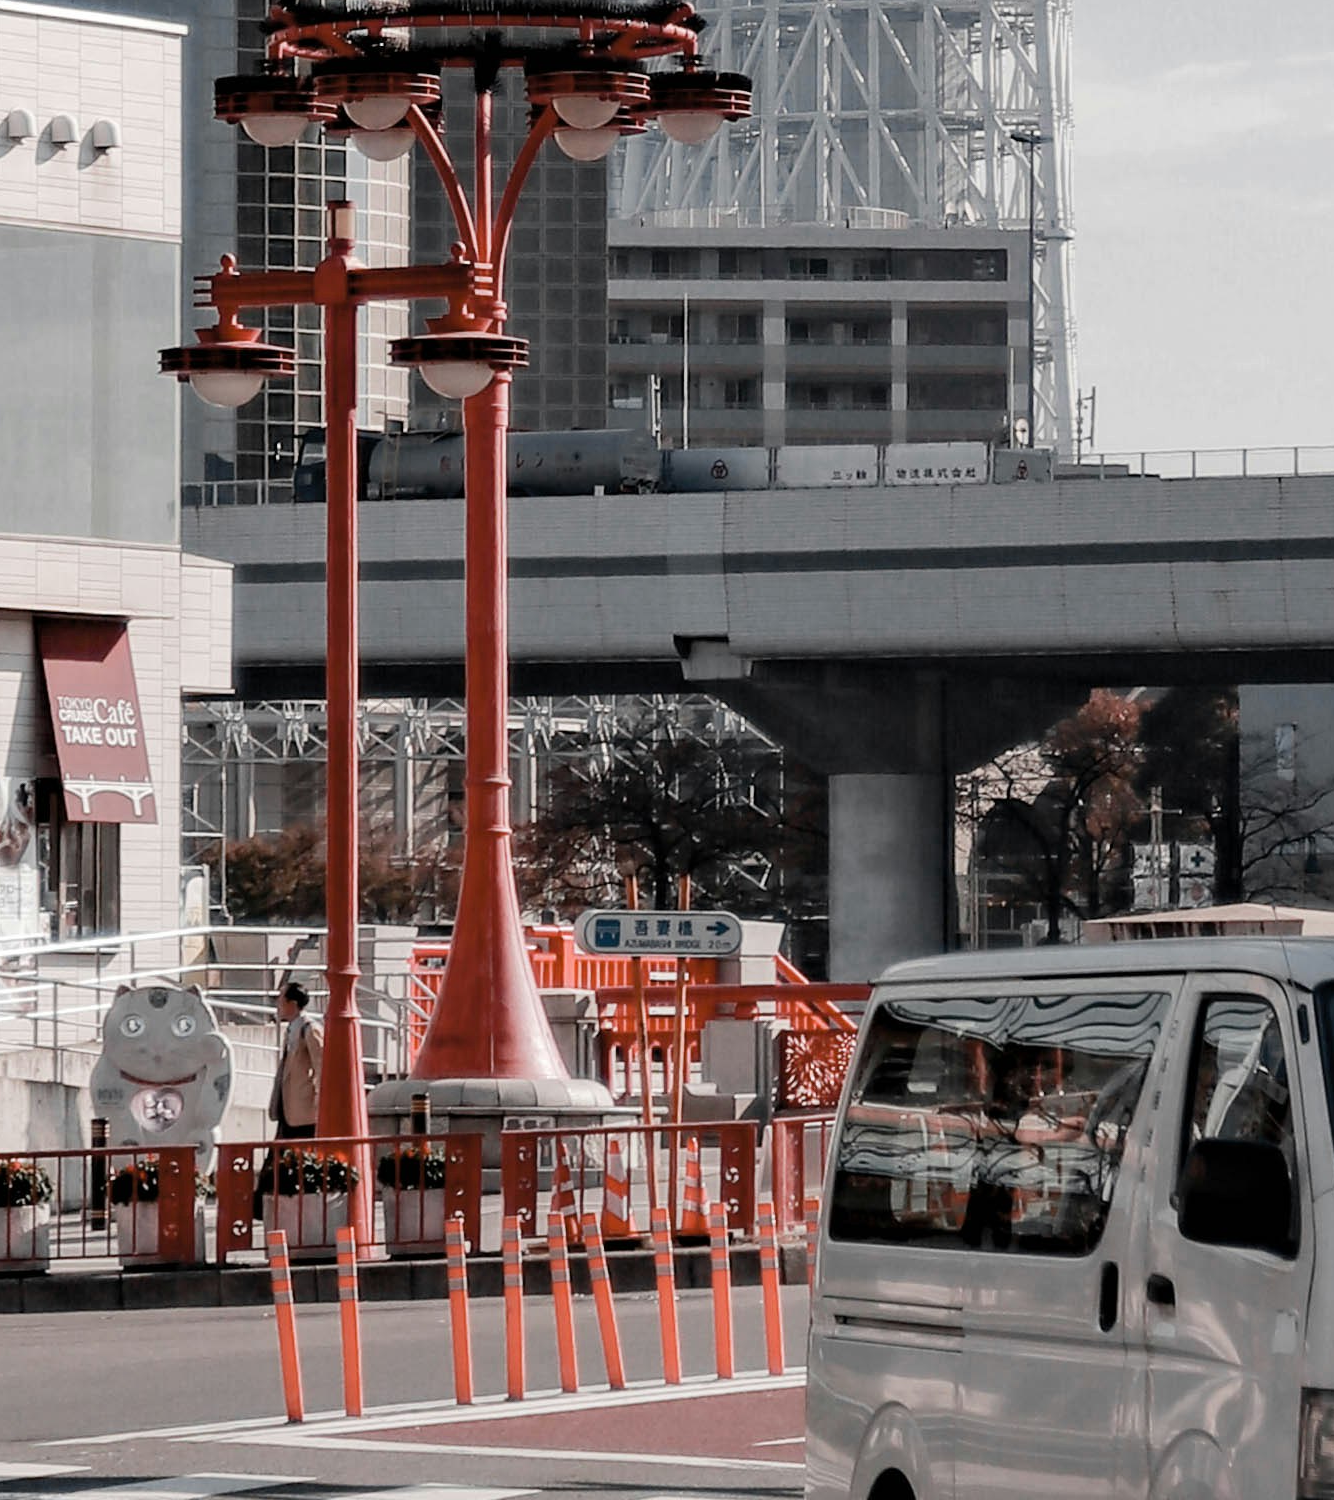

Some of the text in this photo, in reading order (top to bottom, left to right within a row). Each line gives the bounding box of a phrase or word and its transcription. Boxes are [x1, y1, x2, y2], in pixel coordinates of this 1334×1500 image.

[56, 695, 93, 710] TOKYO
[58, 697, 136, 725] CRUISE Café
[61, 725, 138, 747] TAKE OUT
